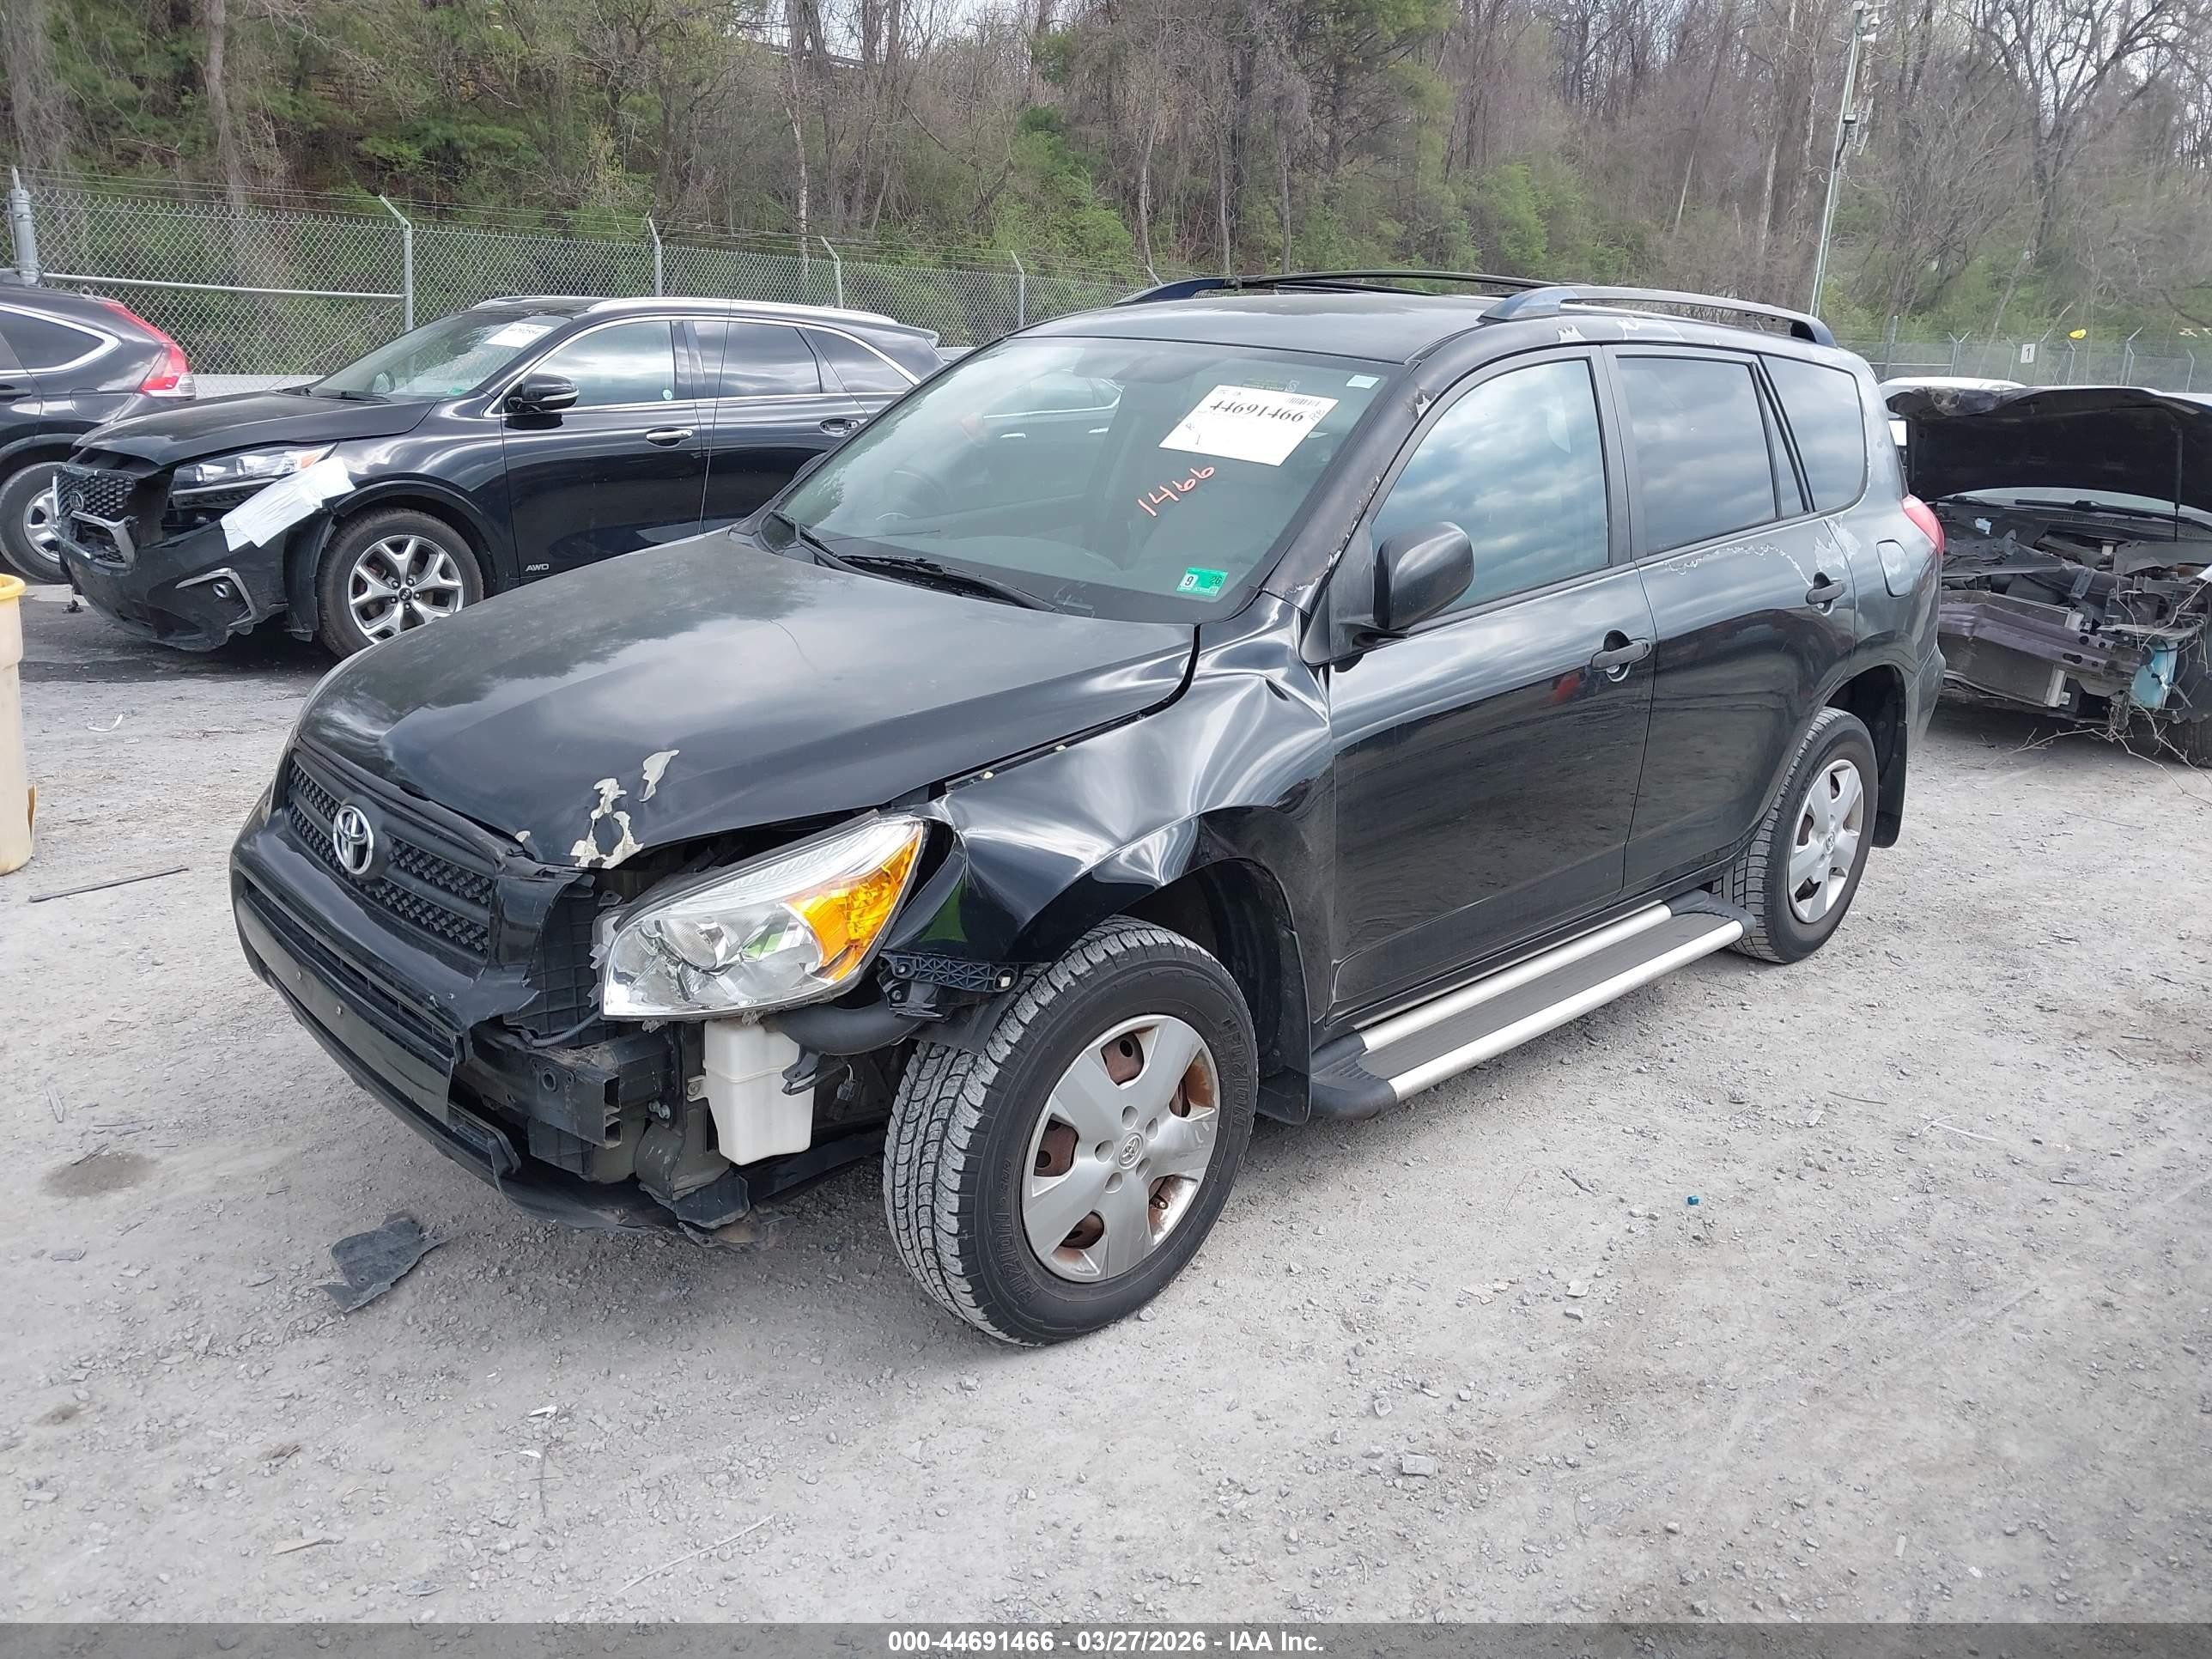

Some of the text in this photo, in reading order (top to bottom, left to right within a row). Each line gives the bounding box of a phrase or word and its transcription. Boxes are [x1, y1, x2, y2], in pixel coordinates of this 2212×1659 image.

[1209, 399, 1307, 422] 44691466
[1137, 466, 1216, 517] 1466
[525, 563, 550, 572] AWD
[1184, 575, 1224, 586] 9 26
[994, 1212, 1040, 1305] FUZION
